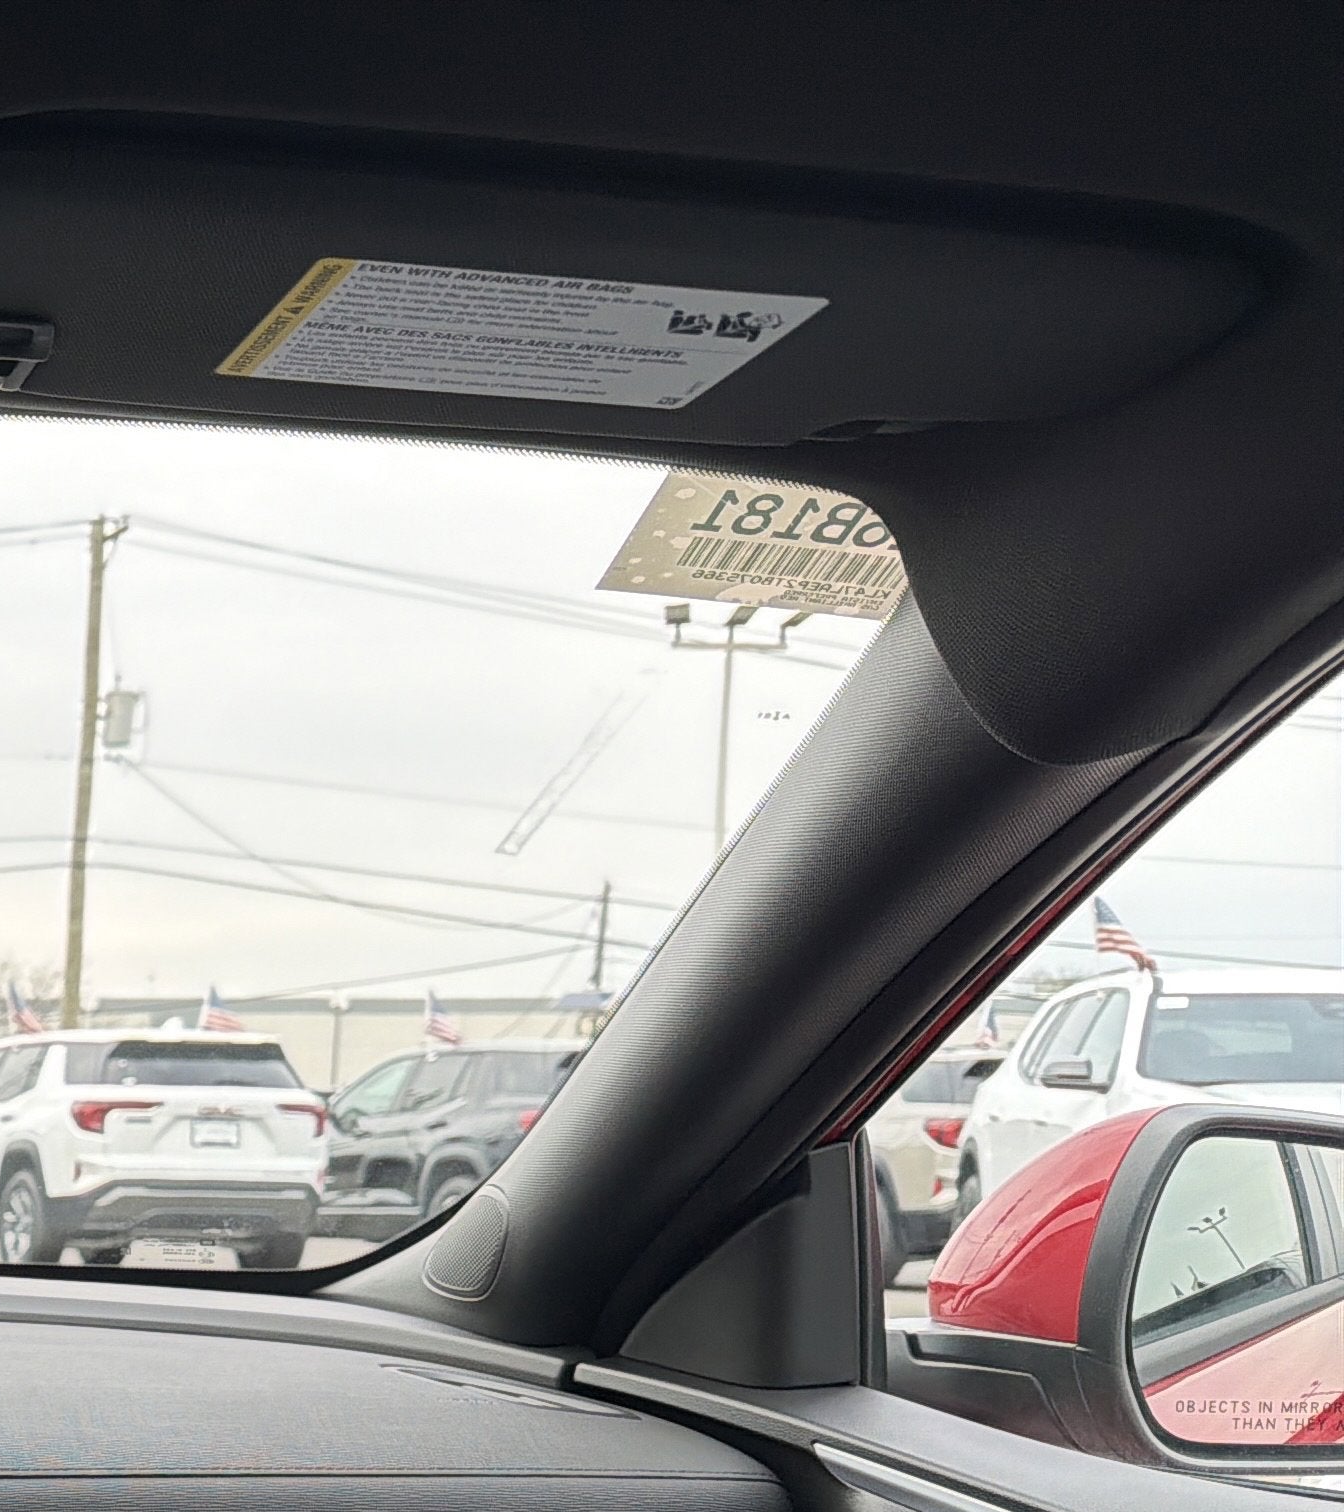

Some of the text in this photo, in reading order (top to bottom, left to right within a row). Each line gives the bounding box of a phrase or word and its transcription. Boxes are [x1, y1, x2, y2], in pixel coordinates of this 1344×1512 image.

[354, 263, 638, 293] EVEN WITH ADVANCED AIR BAGS
[1175, 1400, 1251, 1414] OBJECTS
[1258, 1401, 1273, 1413] IN
[1232, 1417, 1277, 1431] THAN
[1284, 1416, 1326, 1431] THEY
